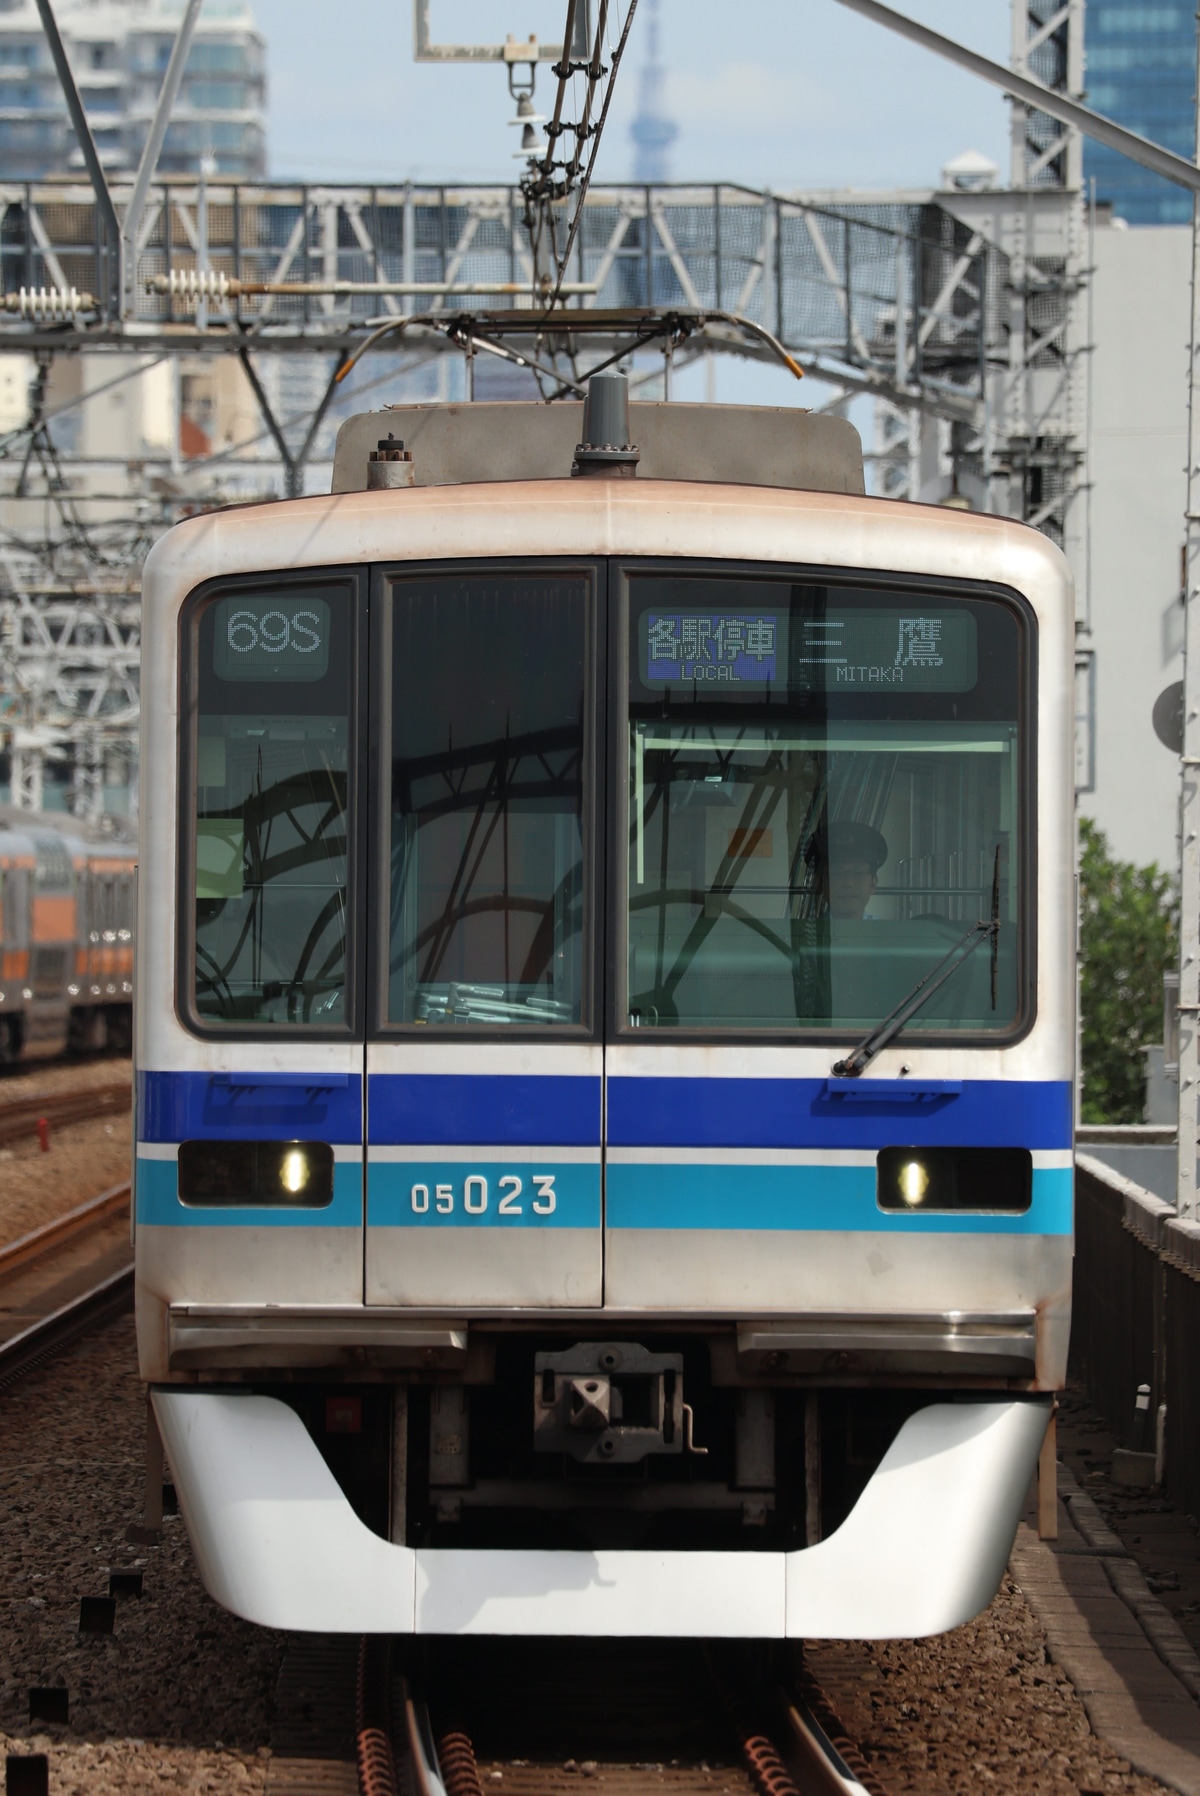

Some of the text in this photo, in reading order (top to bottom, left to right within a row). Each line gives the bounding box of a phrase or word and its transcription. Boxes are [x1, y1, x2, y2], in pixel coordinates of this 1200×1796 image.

[227, 611, 321, 652] 69S
[648, 618, 775, 661] 各駅停車
[681, 665, 741, 681] LOCAL
[836, 666, 904, 682] MITAKA
